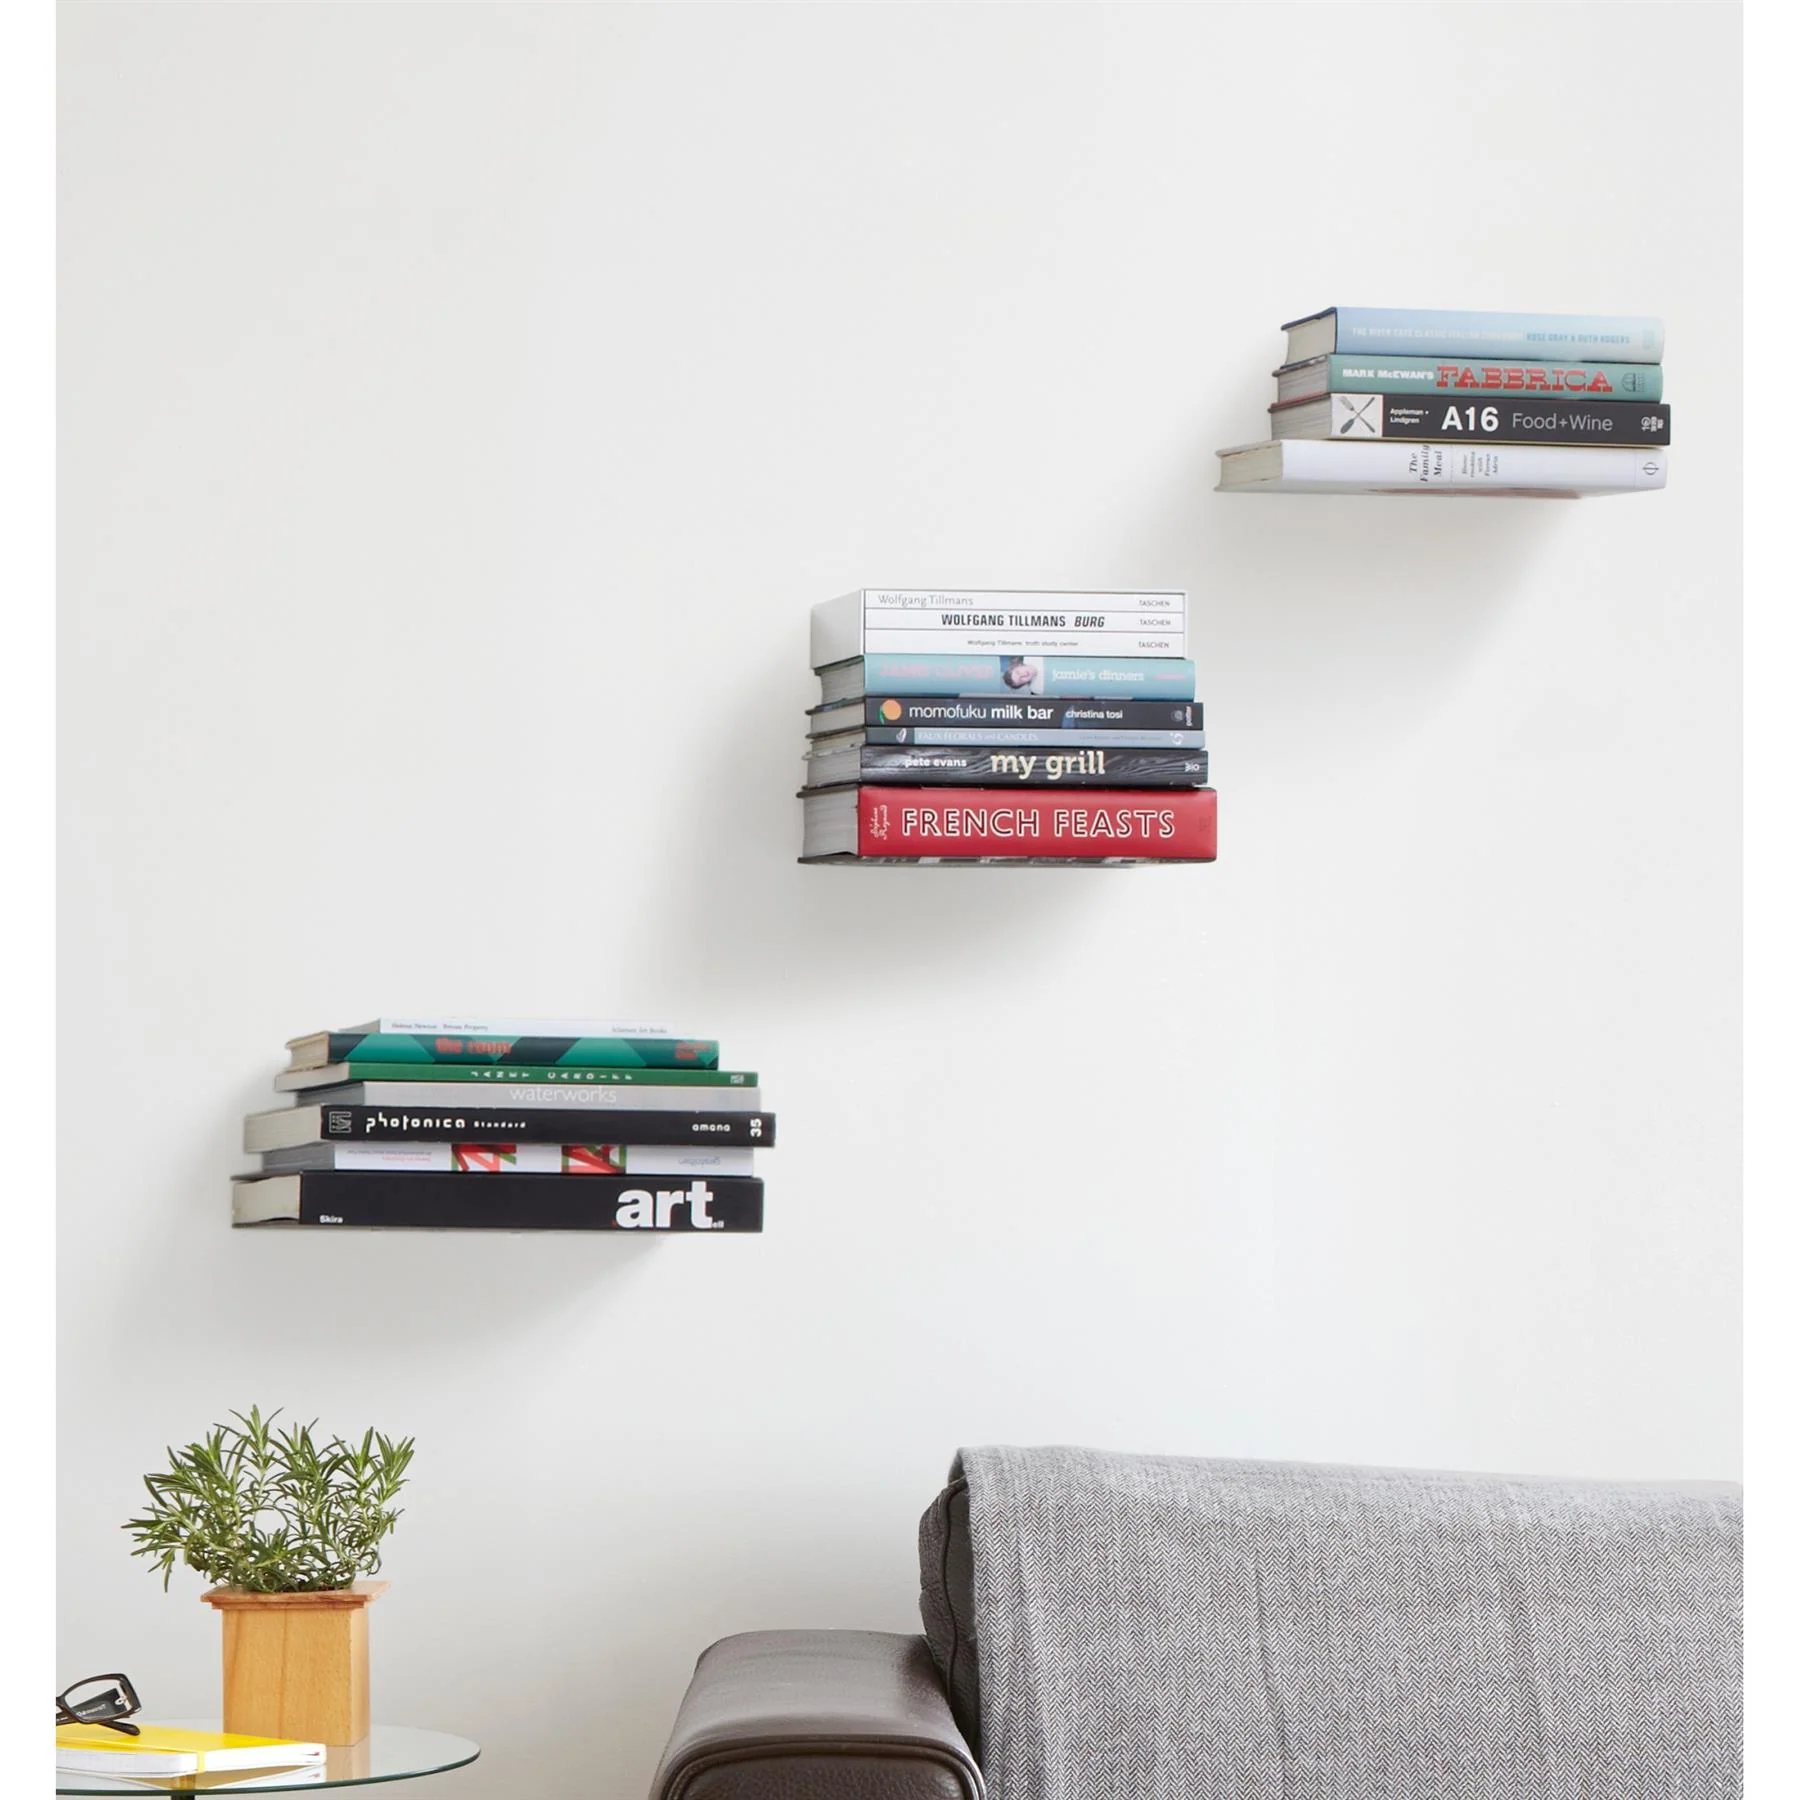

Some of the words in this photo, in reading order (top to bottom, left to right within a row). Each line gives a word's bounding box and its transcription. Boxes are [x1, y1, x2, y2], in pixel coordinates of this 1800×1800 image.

[1342, 368, 1375, 378] MARK
[1436, 365, 1614, 393] FABBRICA
[1441, 405, 1500, 432] A16
[1408, 452, 1418, 474] The
[1420, 444, 1430, 482] Family
[1433, 450, 1442, 477] Meal
[878, 594, 927, 608] Wolfgang
[929, 595, 974, 607] Tillmans
[1138, 599, 1170, 607] TASCHEN
[941, 614, 1004, 627] WOLFGANG
[1008, 615, 1066, 628] TILLMANS
[1074, 616, 1106, 628] BURG
[1139, 618, 1171, 626] TASCHEN
[1138, 640, 1170, 649] TASCHEN
[1051, 669, 1096, 682] jamie's
[1098, 669, 1145, 682] dinners
[909, 704, 987, 719] momofuku
[991, 705, 1023, 719] milk
[1027, 706, 1054, 720] bar
[1065, 707, 1105, 719] christina
[1105, 709, 1124, 720] tosi
[904, 756, 931, 769] pete
[933, 758, 968, 768] evans
[989, 754, 1037, 781] my
[1045, 750, 1106, 781] grill
[902, 808, 1040, 837] FRENCH
[1054, 809, 1176, 839] FEASTS
[470, 1070, 530, 1079] JANET
[547, 1071, 633, 1081] CARDIFF
[509, 1083, 617, 1103] waterworks
[365, 1111, 466, 1133] photonica
[473, 1120, 527, 1129] Standard
[691, 1123, 732, 1132] amana
[749, 1118, 762, 1138] 35
[615, 1180, 714, 1229] art
[319, 1214, 344, 1224] Skira
